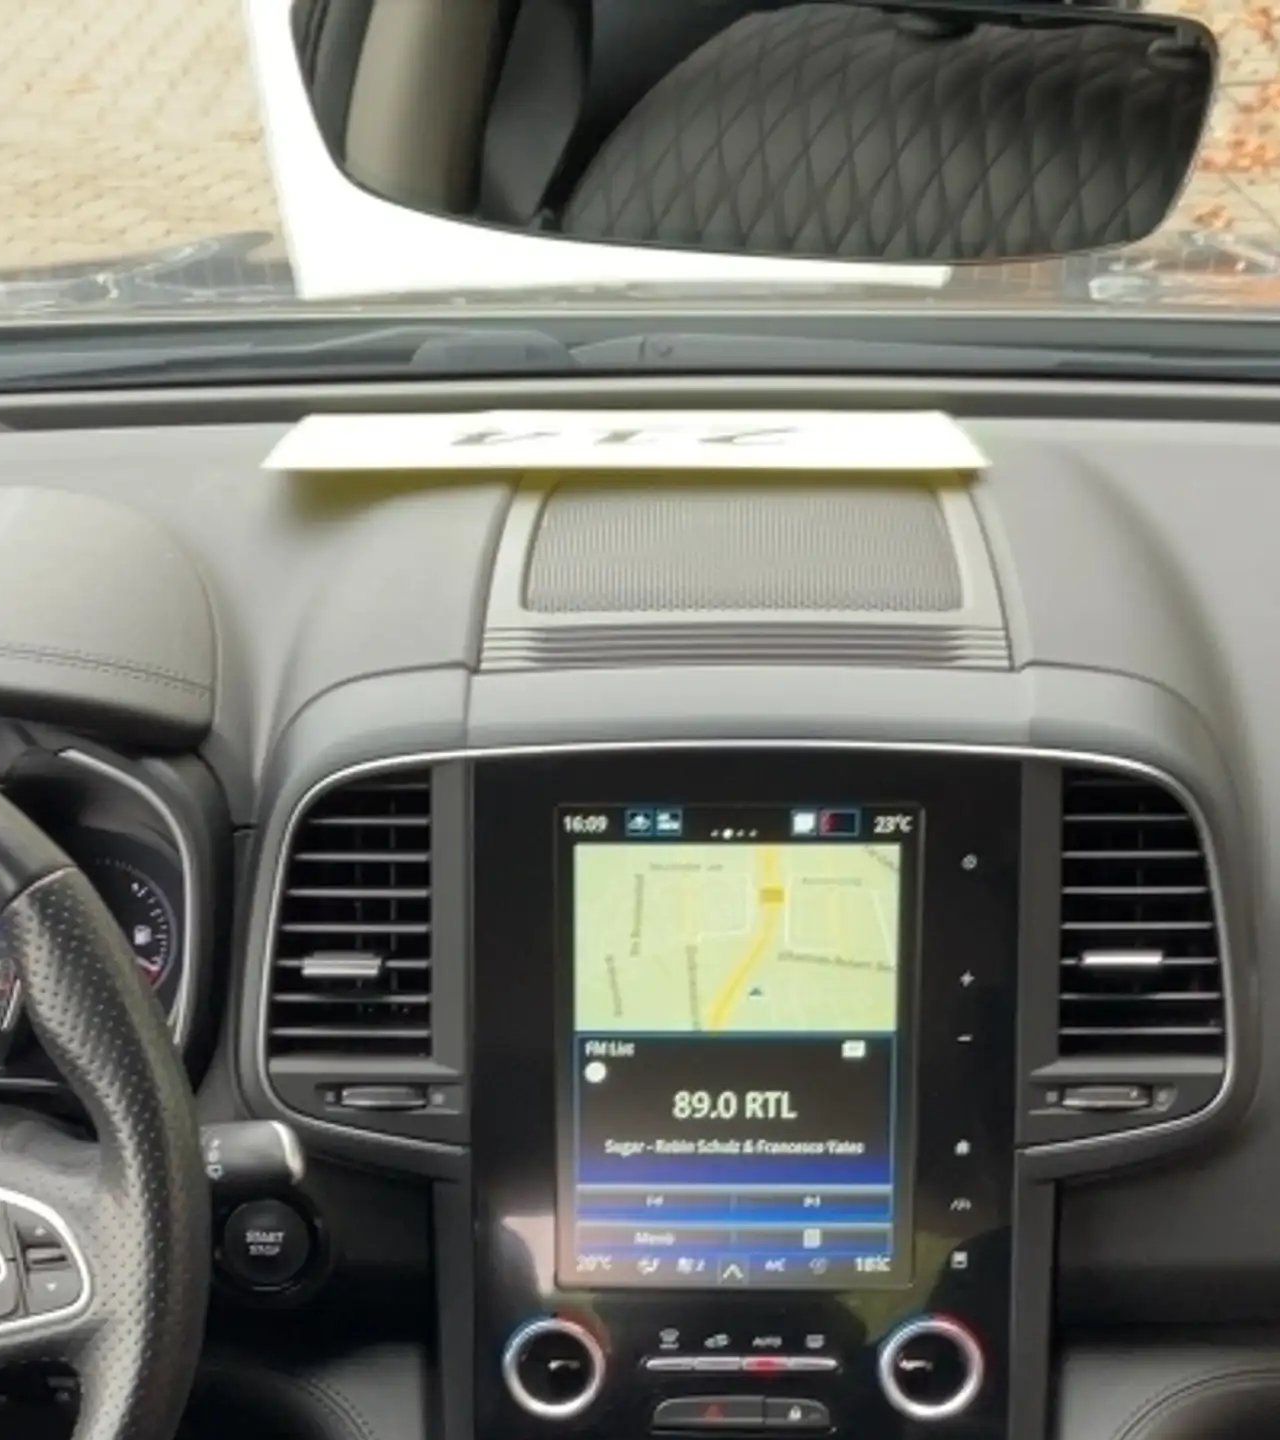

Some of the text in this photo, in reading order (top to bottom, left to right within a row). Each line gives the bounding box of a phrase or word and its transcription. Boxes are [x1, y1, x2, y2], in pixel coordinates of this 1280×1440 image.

[562, 815, 609, 833] 16:09
[874, 814, 913, 833] 23°C
[585, 1040, 606, 1056] FM
[672, 1090, 798, 1120] 89.0 RTL
[605, 1139, 645, 1158] Sugar
[655, 1139, 695, 1154] Robin
[697, 1139, 740, 1154] Schulz
[245, 1230, 285, 1244] START
[248, 1244, 281, 1256] STOP
